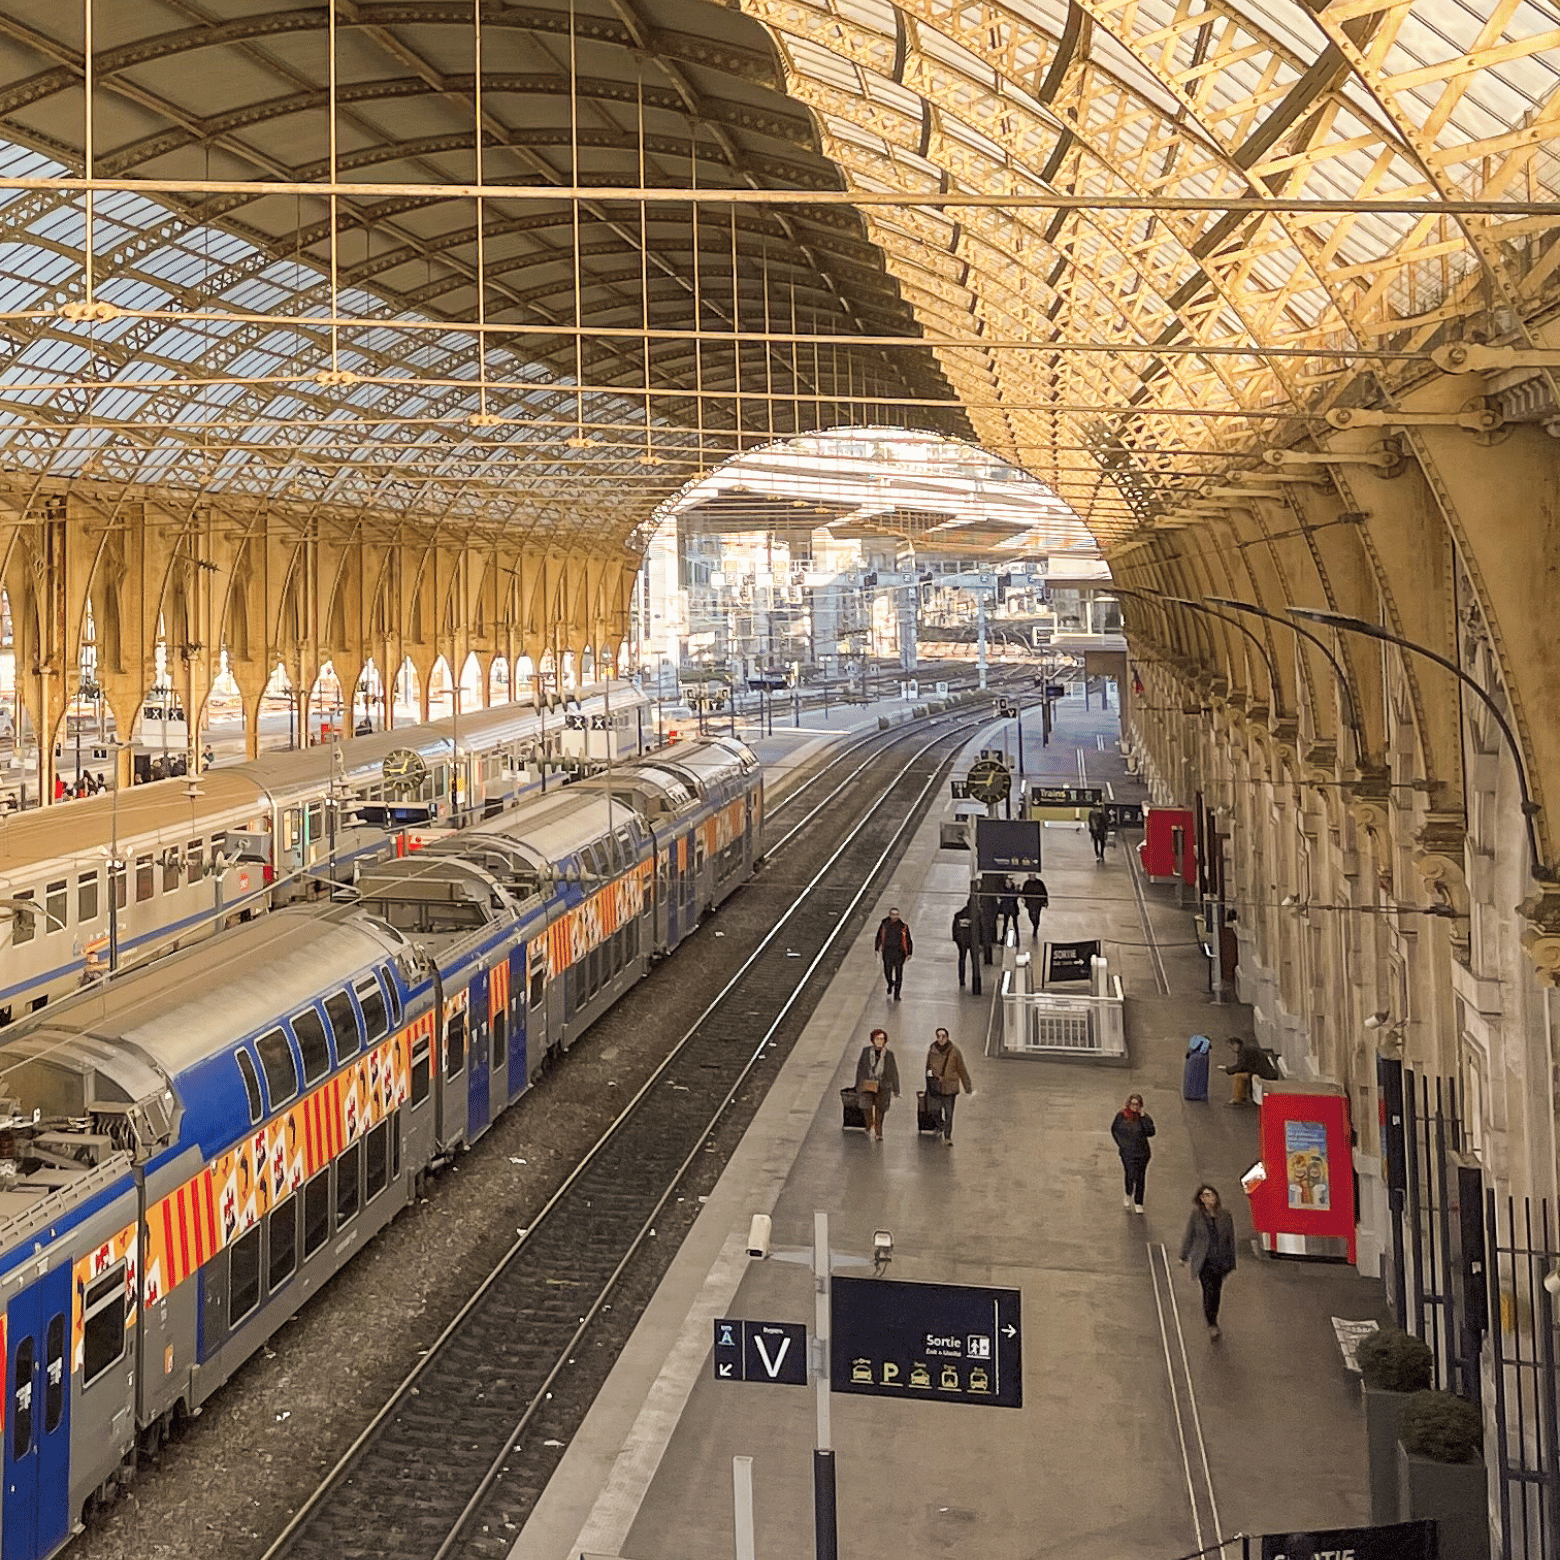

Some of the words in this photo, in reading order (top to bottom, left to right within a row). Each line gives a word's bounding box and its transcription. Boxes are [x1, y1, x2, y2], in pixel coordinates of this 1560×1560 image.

[721, 1330, 733, 1344] A
[926, 1334, 961, 1348] Sortie
[753, 1334, 791, 1378] V
